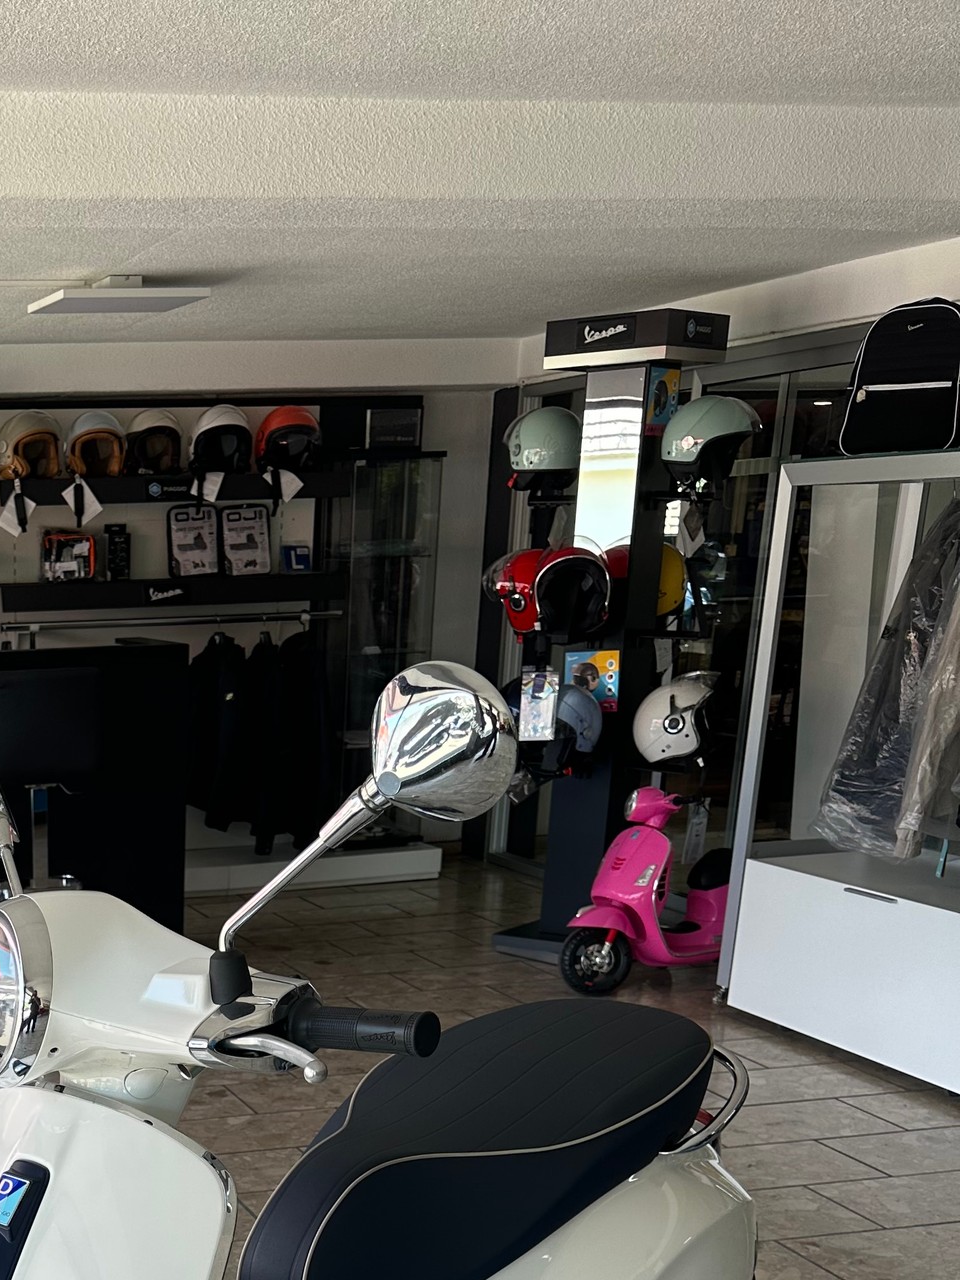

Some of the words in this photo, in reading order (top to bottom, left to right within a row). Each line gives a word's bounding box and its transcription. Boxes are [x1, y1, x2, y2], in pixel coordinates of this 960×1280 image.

[584, 324, 628, 344] Vespa
[227, 510, 257, 522] OJ
[149, 587, 184, 601] Vespa
